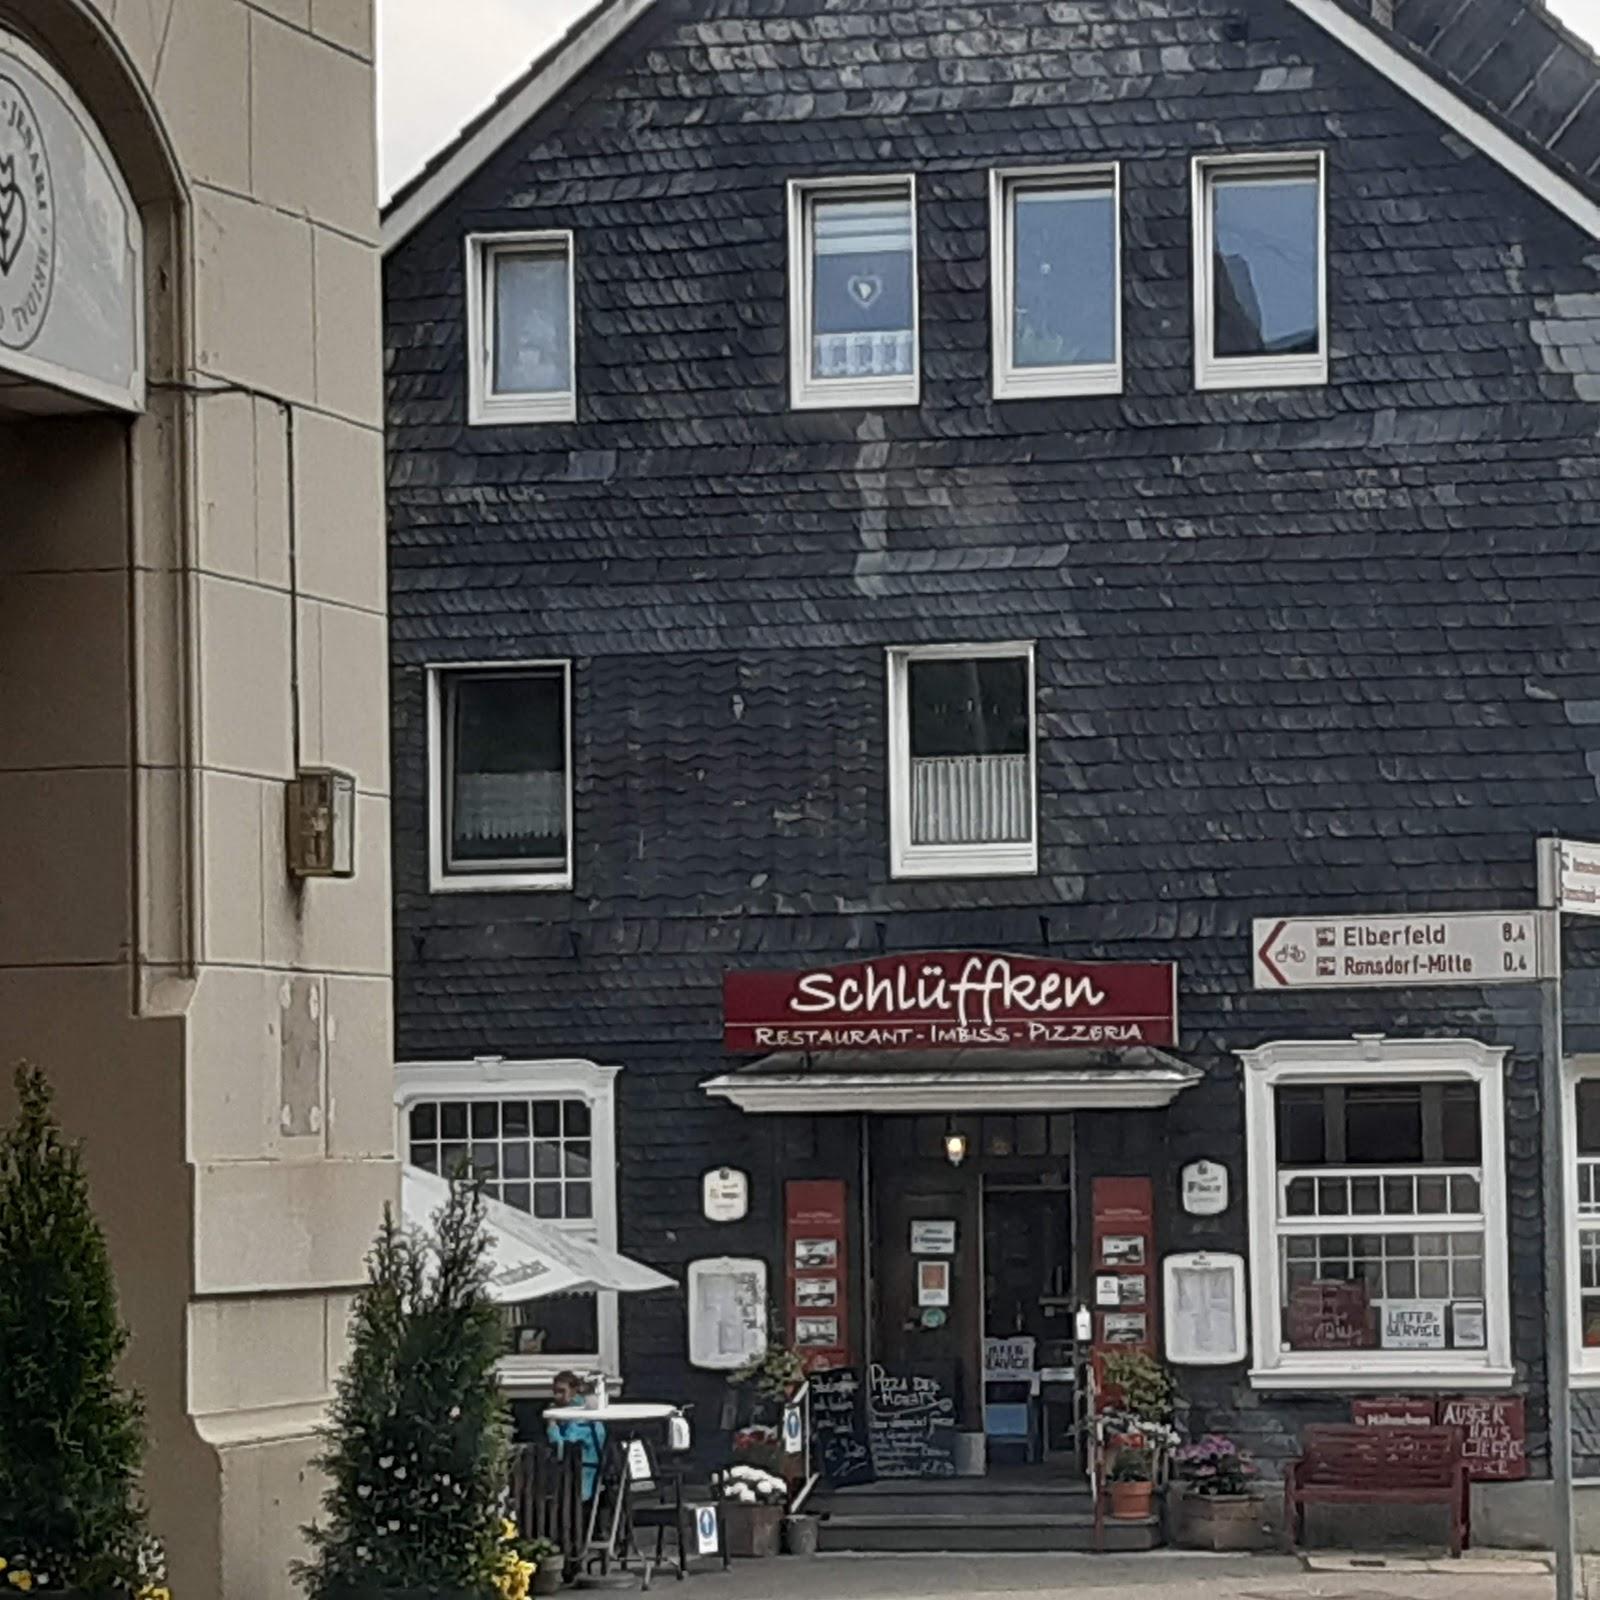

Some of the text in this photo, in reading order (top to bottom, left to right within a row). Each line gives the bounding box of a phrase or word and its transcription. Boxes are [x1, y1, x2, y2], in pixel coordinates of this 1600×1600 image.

[1344, 924, 1446, 946] Elberfeld
[1344, 954, 1472, 976] Ronsdorf-Mitte
[790, 957, 1105, 1027] Schlüffken
[755, 1027, 913, 1046] RESTAURANT
[931, 1023, 1010, 1044] IMBISS
[1029, 1021, 1143, 1042] PIZZERIA
